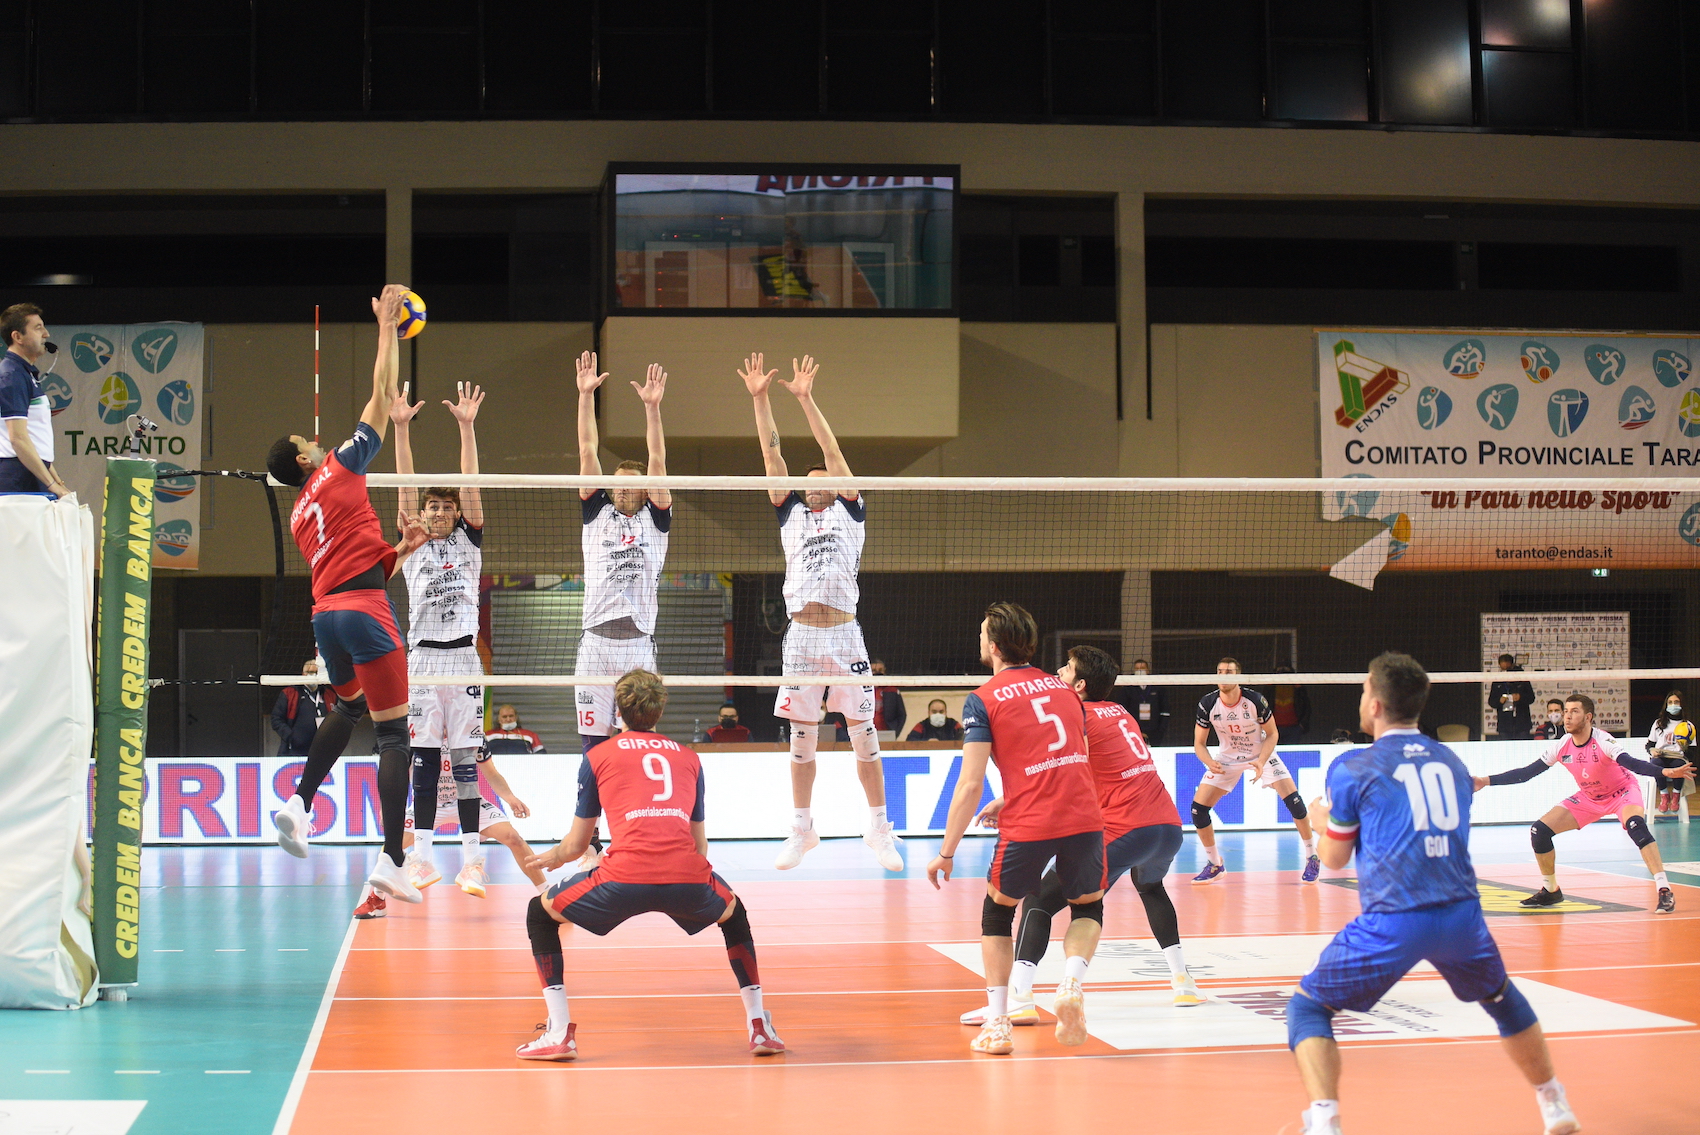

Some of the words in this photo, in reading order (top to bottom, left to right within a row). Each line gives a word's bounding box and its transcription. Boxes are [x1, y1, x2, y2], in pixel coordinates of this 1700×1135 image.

[1355, 393, 1397, 433] ENDAS
[1345, 439, 1468, 465] COMITATO
[1478, 440, 1634, 466] PROVINCIALE
[311, 466, 333, 494] DIAZ
[126, 477, 155, 581] BANCA
[304, 501, 325, 545] 7
[1495, 546, 1613, 560] taranto@endas.it
[121, 591, 147, 710] CREDEM
[578, 710, 595, 727] 15
[780, 696, 791, 712] 2
[408, 723, 416, 739] 4
[1030, 695, 1067, 752] 5
[1118, 718, 1149, 760] 6
[1228, 724, 1242, 733] 13
[617, 738, 681, 752] GIRONI
[117, 728, 143, 830] BANCA
[641, 752, 673, 802] 9
[1581, 767, 1590, 779] 6
[1392, 761, 1460, 832] 10
[1424, 835, 1450, 858] GOI
[115, 842, 140, 959] CREDEM
